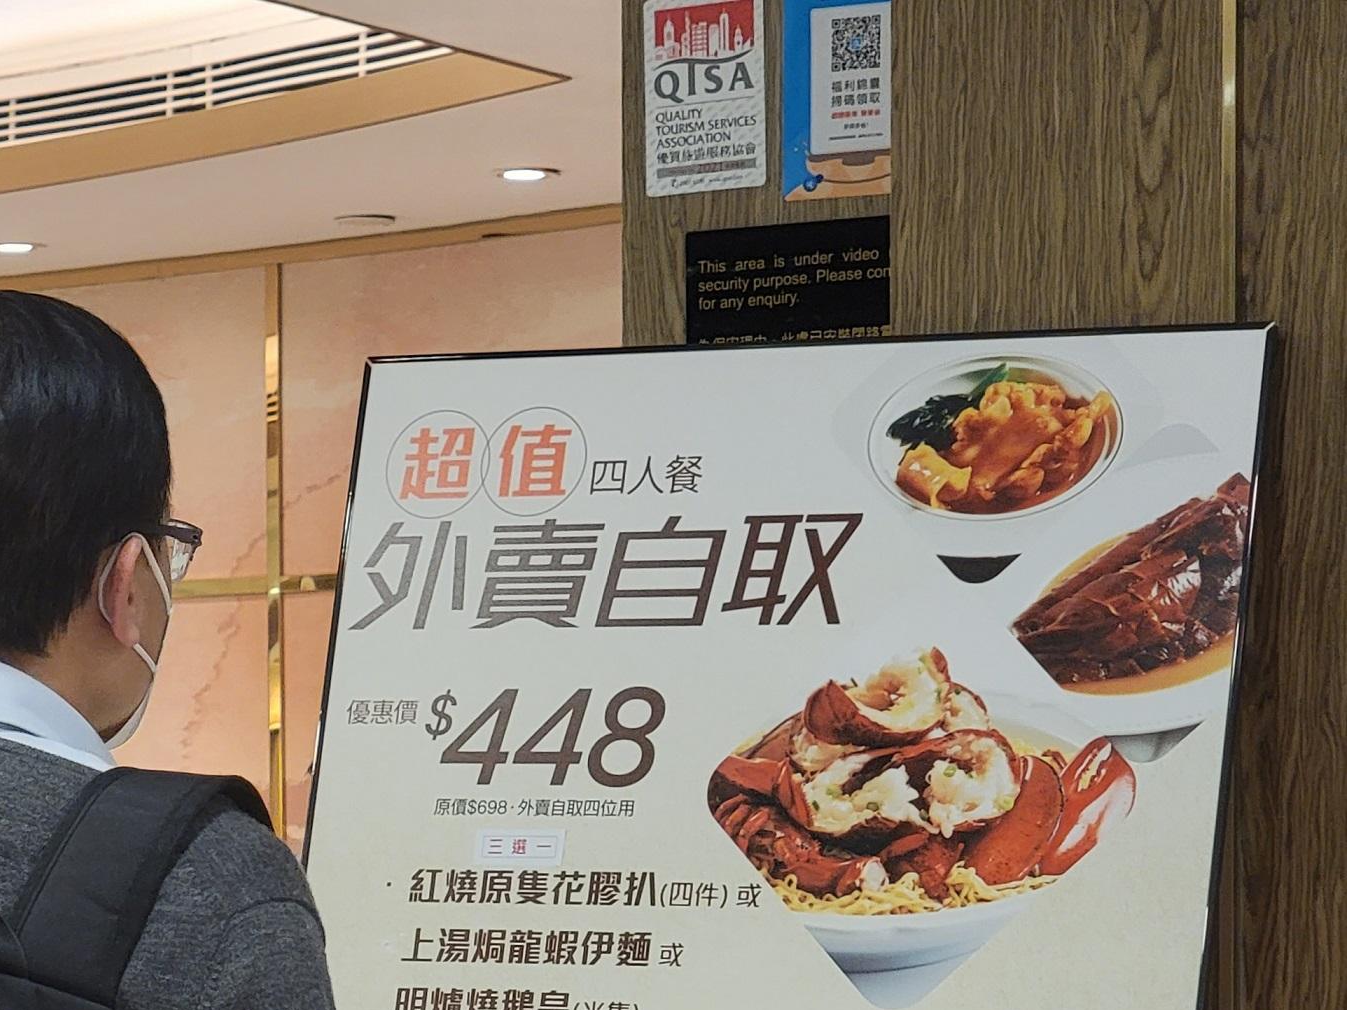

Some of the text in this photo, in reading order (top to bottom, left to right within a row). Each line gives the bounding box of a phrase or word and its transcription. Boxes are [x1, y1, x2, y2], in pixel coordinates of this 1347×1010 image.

[654, 60, 755, 104] QTSA
[656, 109, 702, 124] QUALITY
[656, 115, 756, 136] TOURISM SERVICES
[657, 131, 731, 149] ASSOCIATION
[697, 248, 880, 274] This area is under video
[698, 277, 750, 293] security
[753, 272, 812, 291] purpose.
[816, 268, 863, 283] Please
[698, 290, 800, 311] for any enquiry.
[399, 424, 703, 500] 超值 四人餐
[348, 512, 863, 630] 外賣自取
[346, 686, 665, 787] 優惠價 $448
[487, 838, 552, 855] 三選一
[409, 868, 761, 908] 紅燒原隻花膠扒(四件) 或
[401, 928, 684, 967] 上湯焗龍蝦伊麵 或
